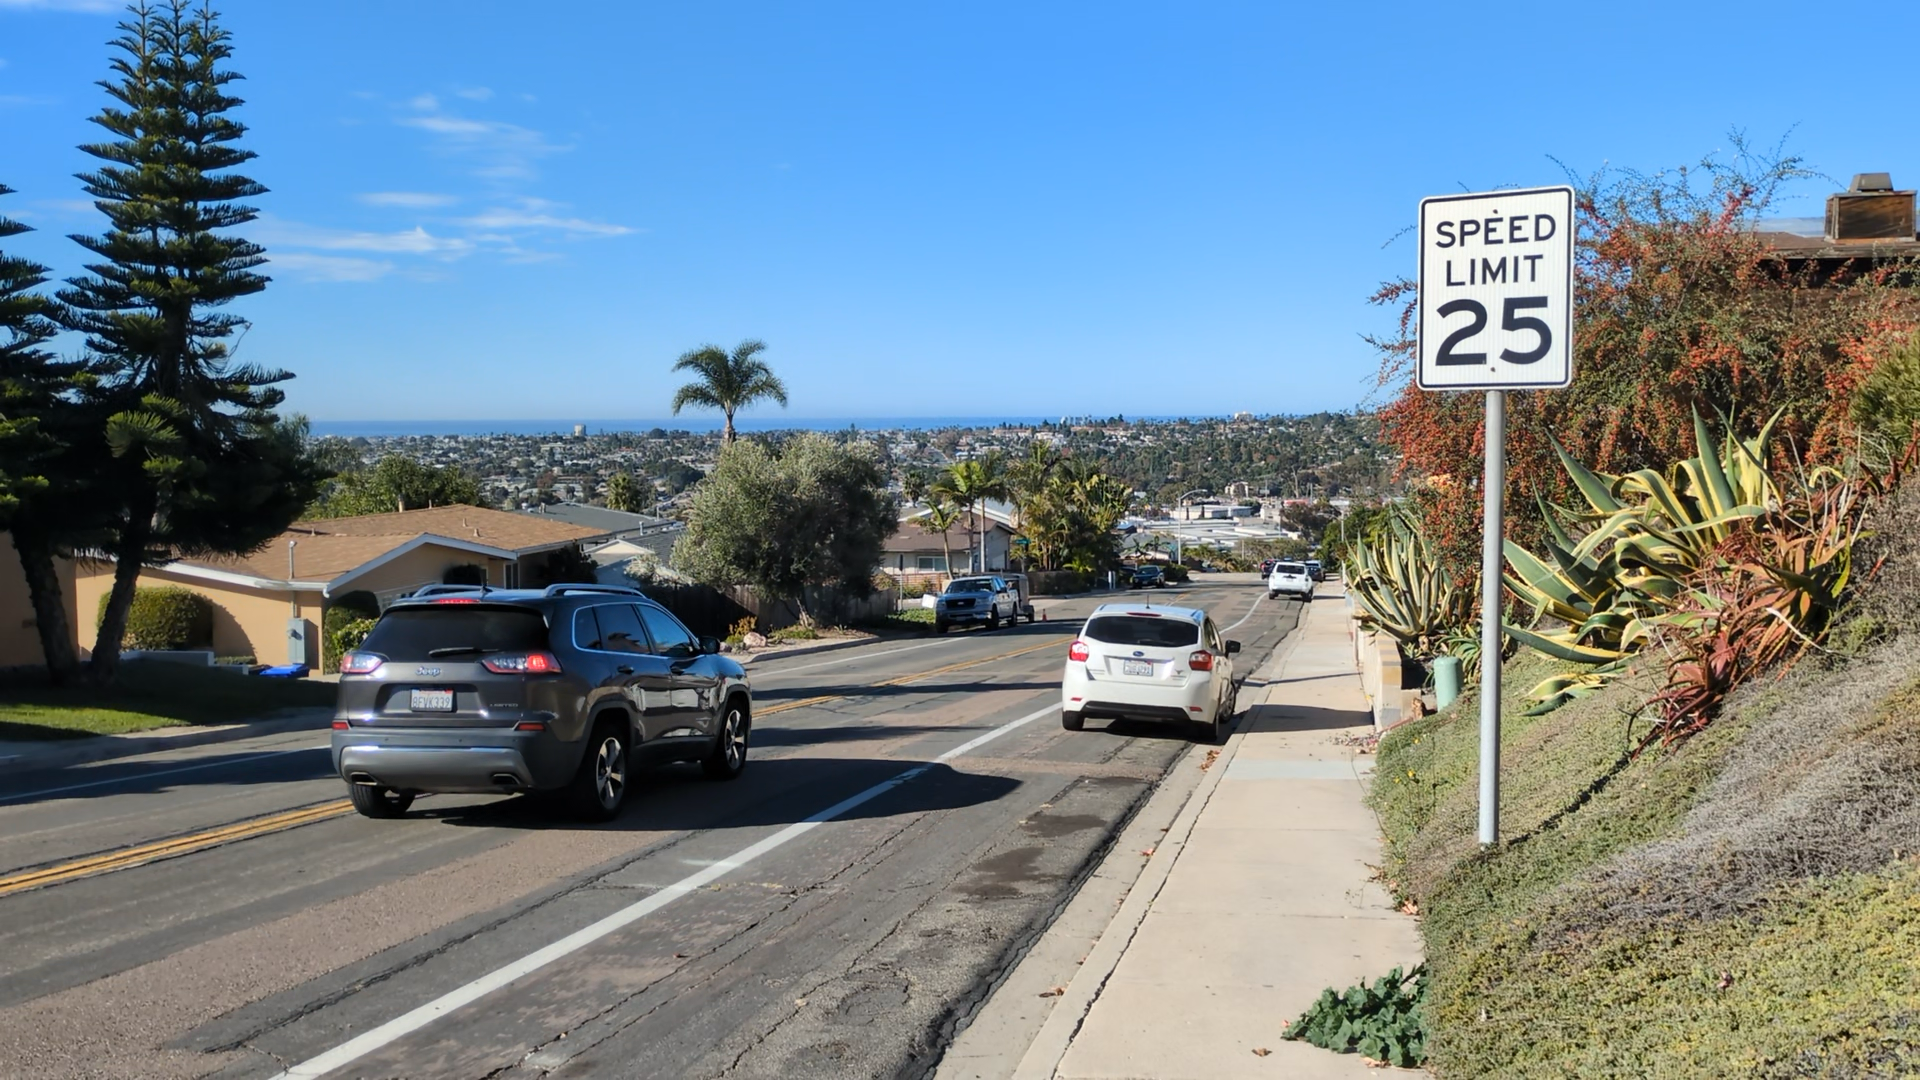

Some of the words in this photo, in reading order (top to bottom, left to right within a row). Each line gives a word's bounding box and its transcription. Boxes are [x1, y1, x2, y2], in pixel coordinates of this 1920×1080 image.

[1436, 214, 1556, 248] SPEED
[1446, 254, 1544, 287] LIMIT
[1435, 296, 1553, 366] 25
[415, 665, 441, 677] Jeep
